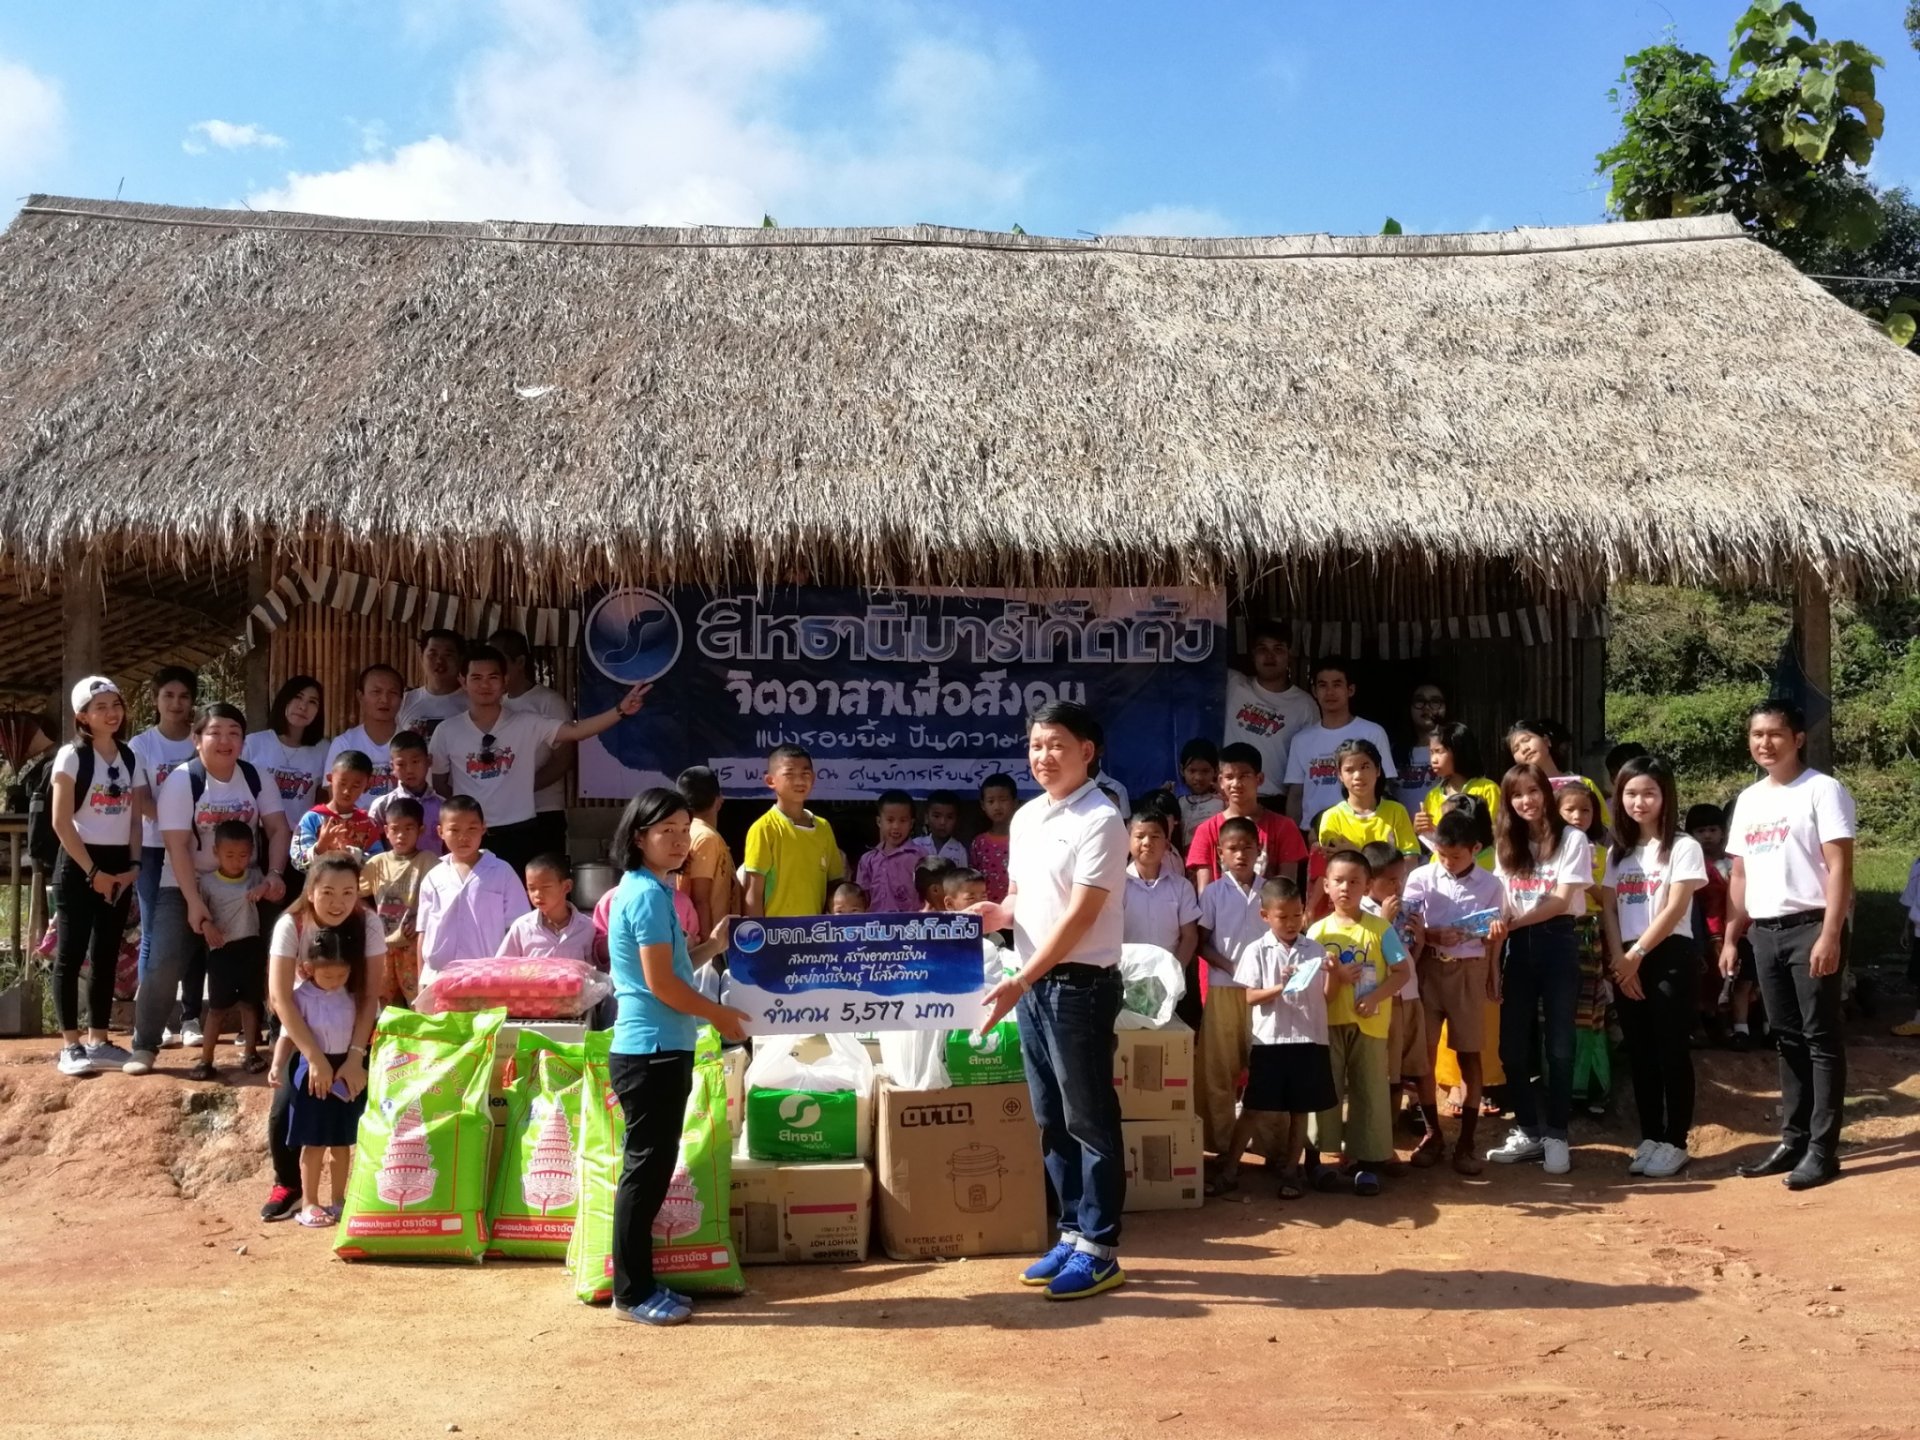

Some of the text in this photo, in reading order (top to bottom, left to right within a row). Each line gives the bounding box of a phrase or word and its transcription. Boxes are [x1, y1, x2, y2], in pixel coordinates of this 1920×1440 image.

[756, 719, 896, 748] แบ่งรอยยิ้ม
[1744, 825, 1791, 847] PARTY
[1616, 879, 1663, 898] PARTY
[764, 999, 954, 1025] จำนวน 5,577 บาท
[900, 1102, 972, 1127] OTTO
